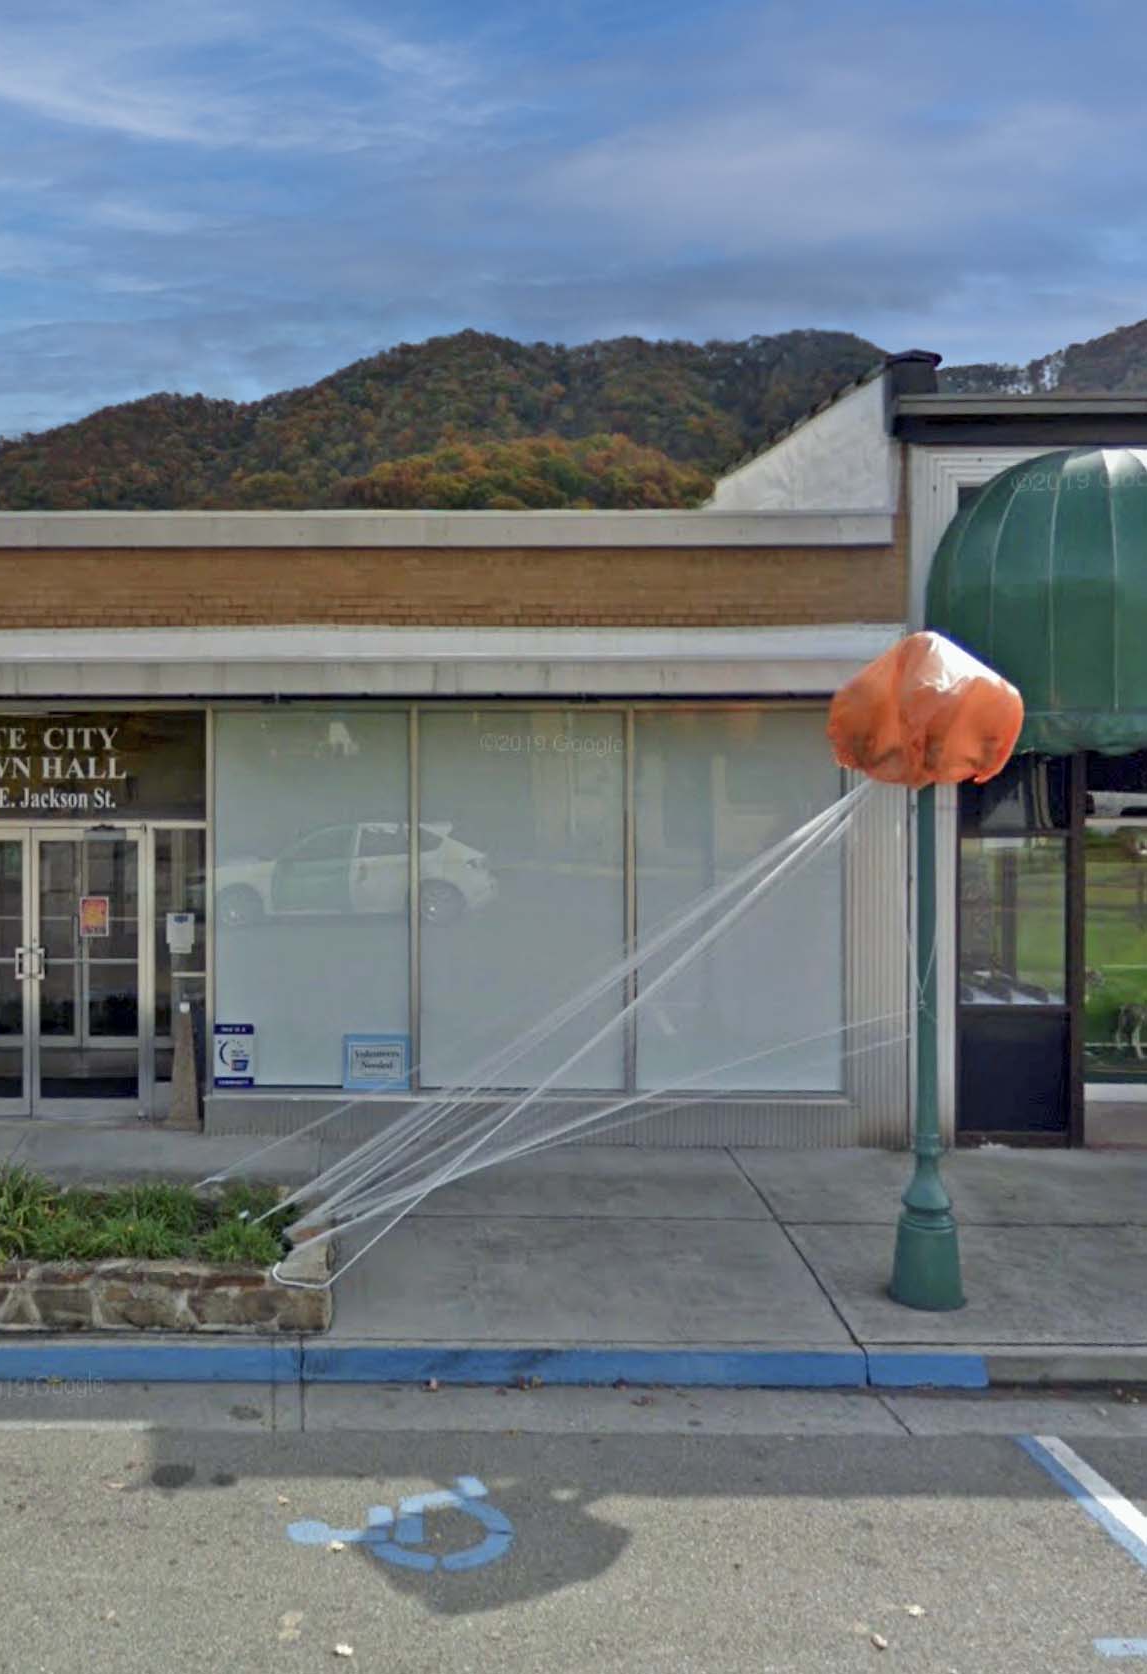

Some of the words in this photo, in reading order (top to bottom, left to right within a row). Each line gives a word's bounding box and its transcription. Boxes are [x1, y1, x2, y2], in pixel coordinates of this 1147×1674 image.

[43, 727, 118, 750] CITY
[42, 756, 126, 778] HALL
[19, 787, 88, 808] Jackson
[94, 787, 116, 808] St.
